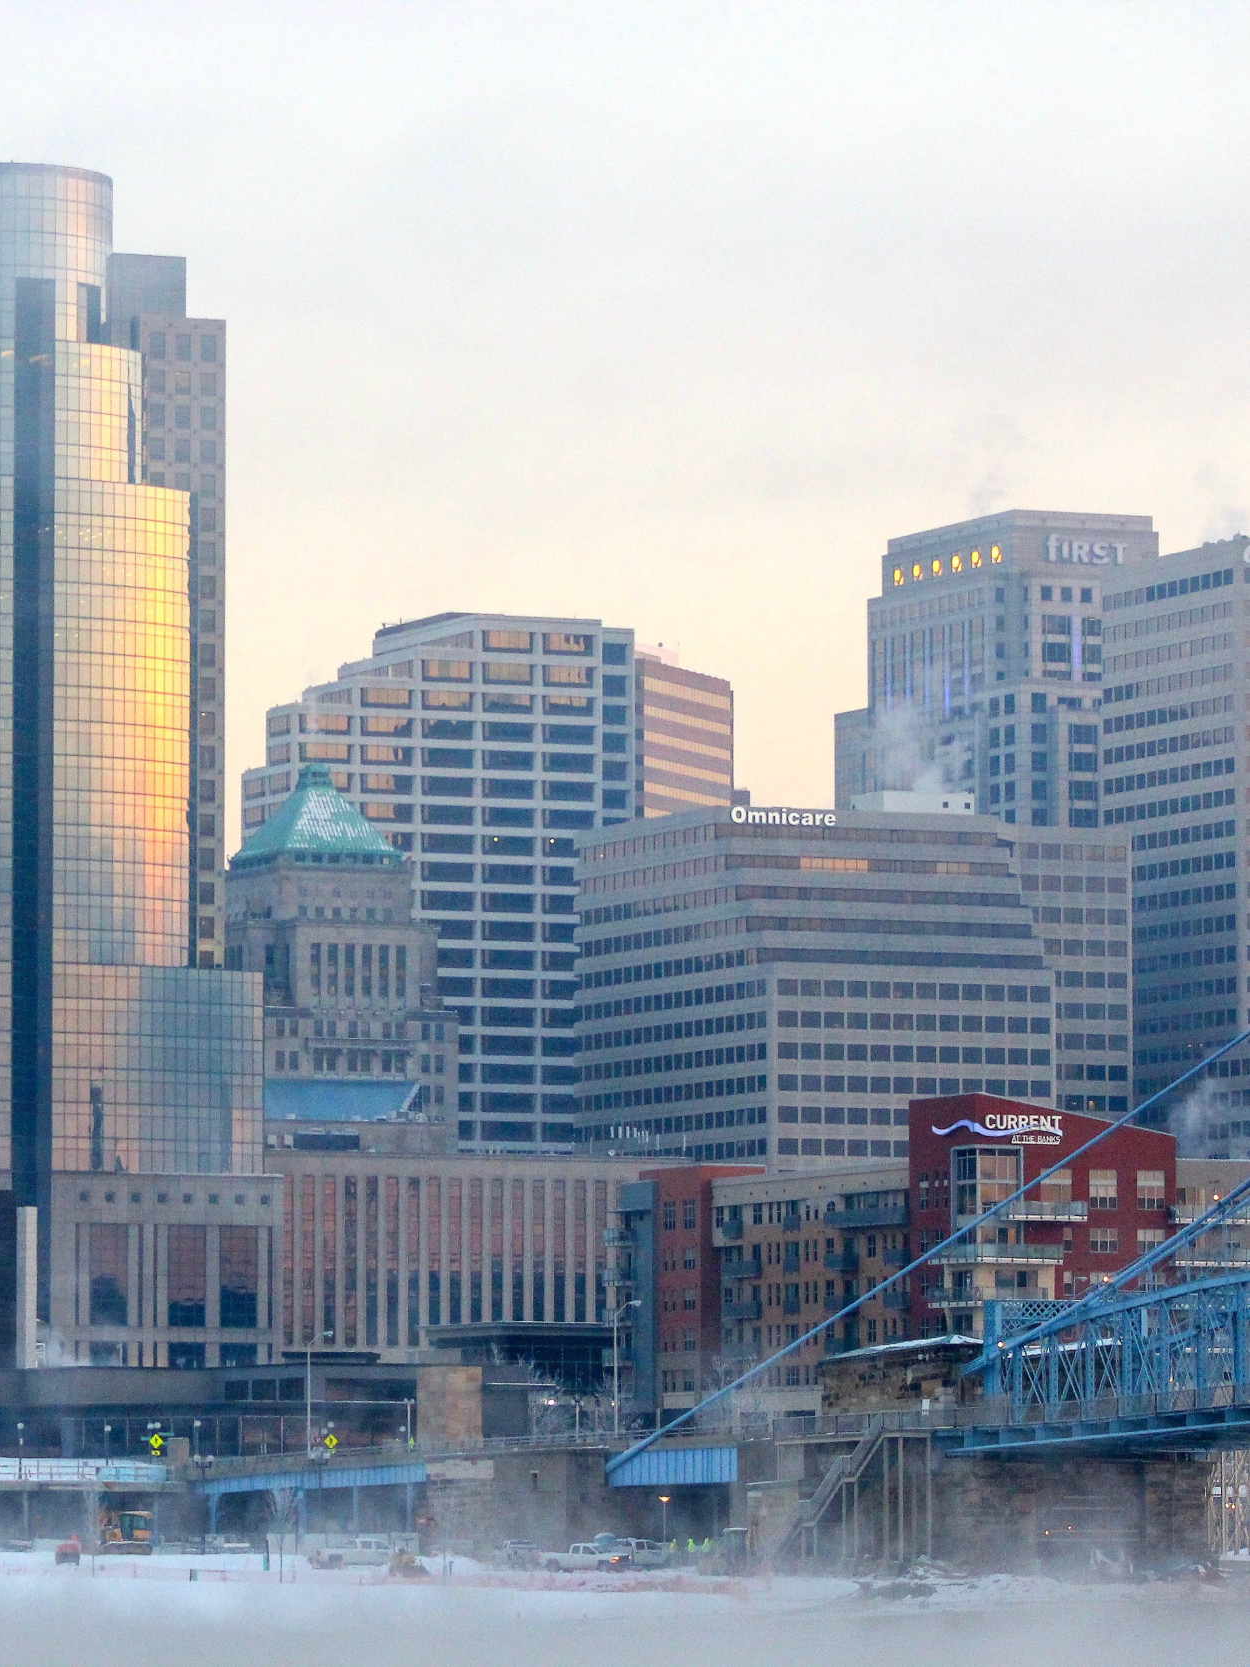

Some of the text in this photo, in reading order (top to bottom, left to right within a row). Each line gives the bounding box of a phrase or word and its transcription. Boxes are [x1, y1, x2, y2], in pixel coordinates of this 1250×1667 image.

[730, 806, 837, 826] Omnicare
[985, 1113, 1062, 1130] CURRENT
[1011, 1134, 1061, 1144] AT THE BANKS
